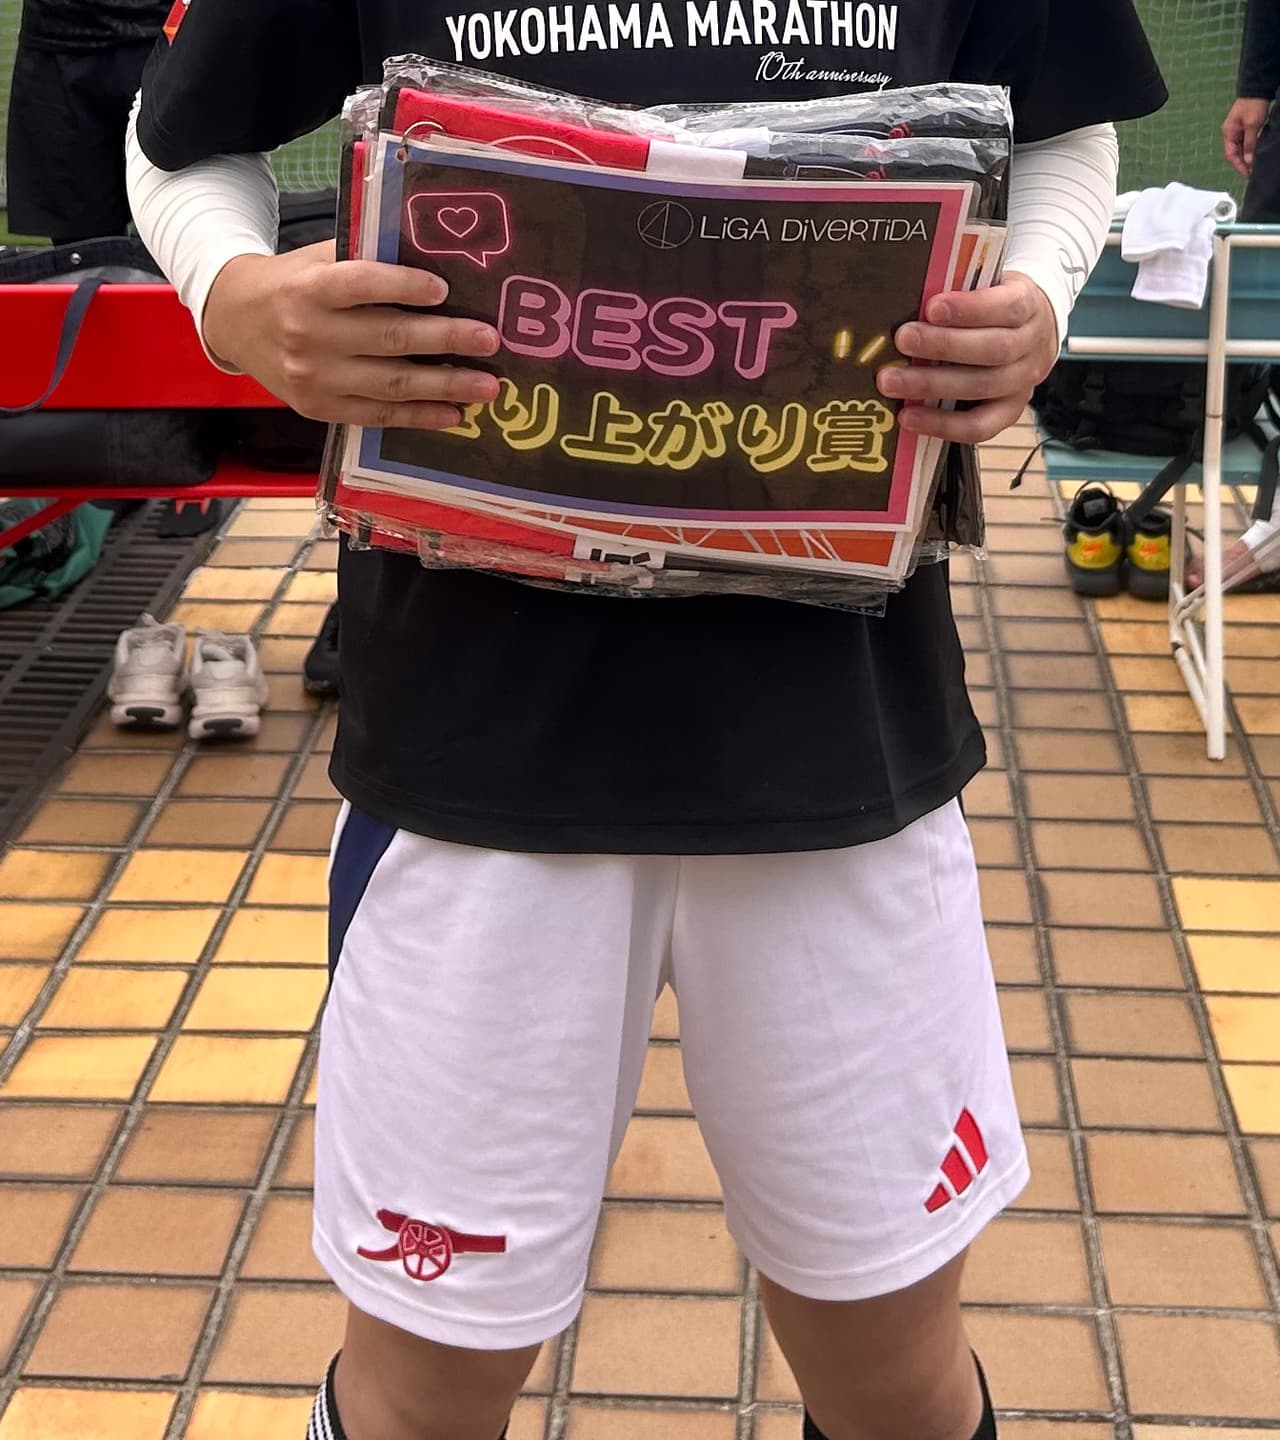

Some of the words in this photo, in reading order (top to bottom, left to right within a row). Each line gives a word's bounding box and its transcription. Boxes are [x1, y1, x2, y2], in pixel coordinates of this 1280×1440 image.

[445, 1, 674, 62] YOKOHAMA
[755, 51, 806, 81] 10th
[806, 69, 893, 93] anniversary
[496, 273, 798, 380] BEST
[437, 375, 896, 474] り上がり賞
